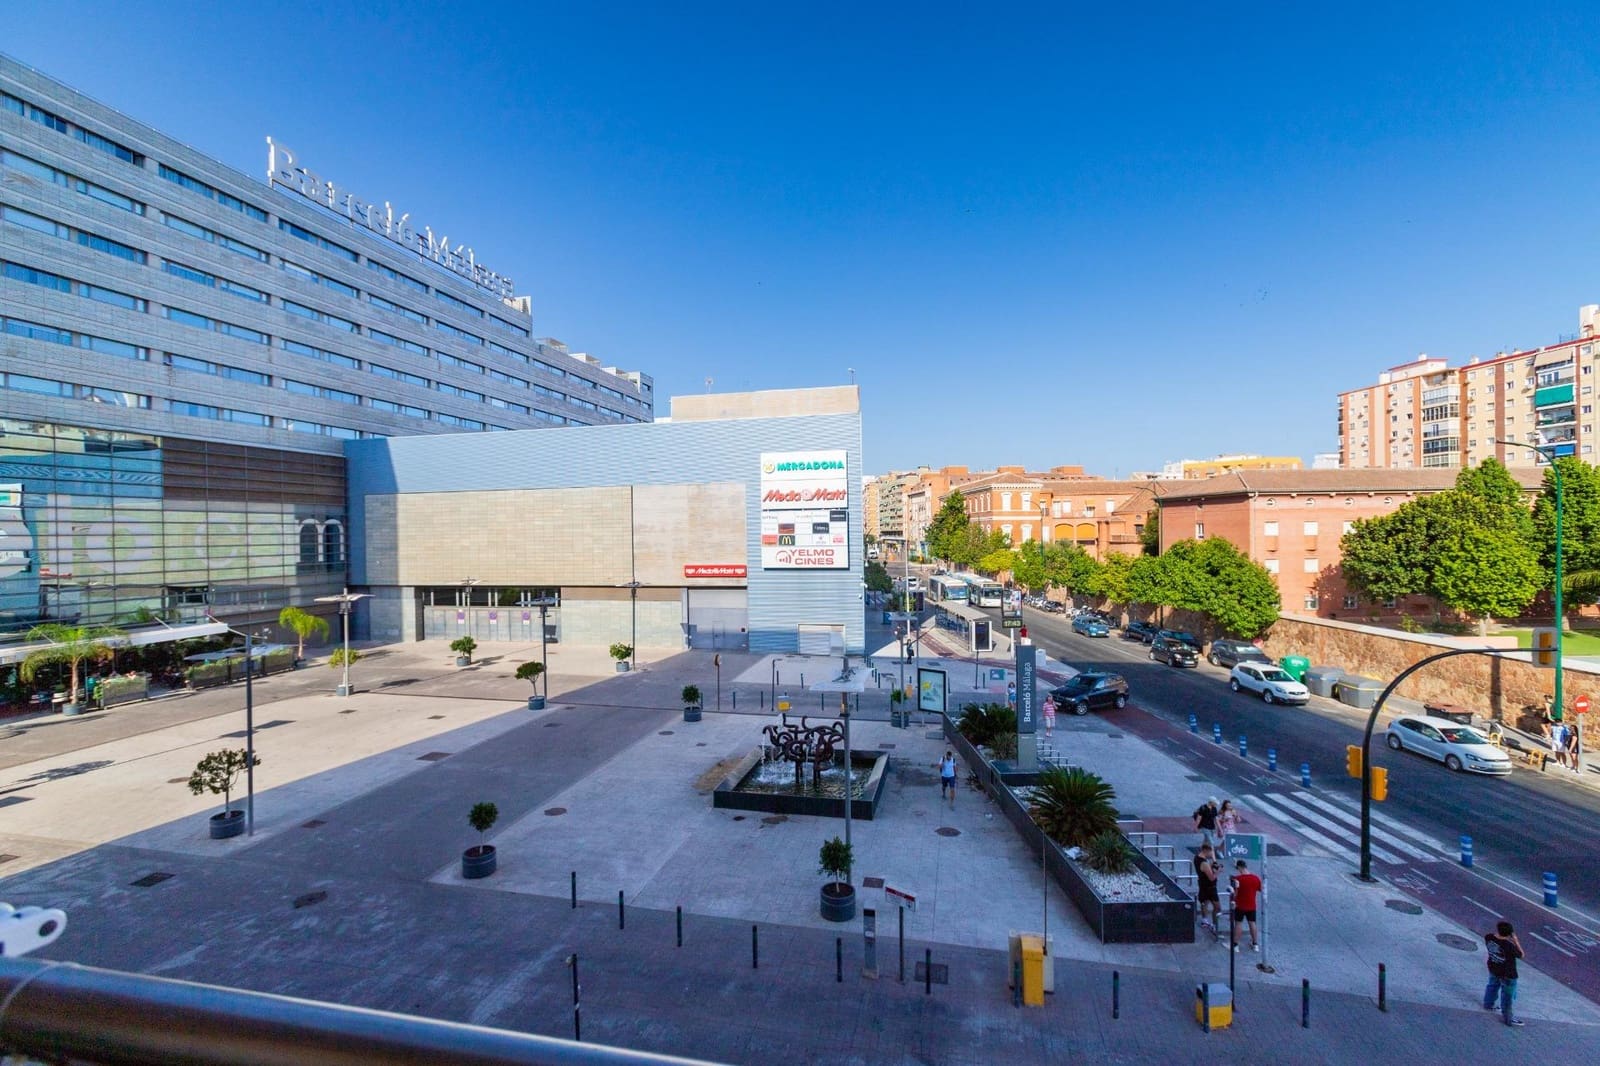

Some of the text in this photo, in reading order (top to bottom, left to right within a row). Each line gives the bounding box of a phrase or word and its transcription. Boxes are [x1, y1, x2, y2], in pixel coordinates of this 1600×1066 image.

[777, 461, 844, 472] MERCADONA
[790, 548, 835, 557] YELMO
[795, 557, 834, 566] CINES
[1023, 662, 1032, 722] Barceló Málaga
